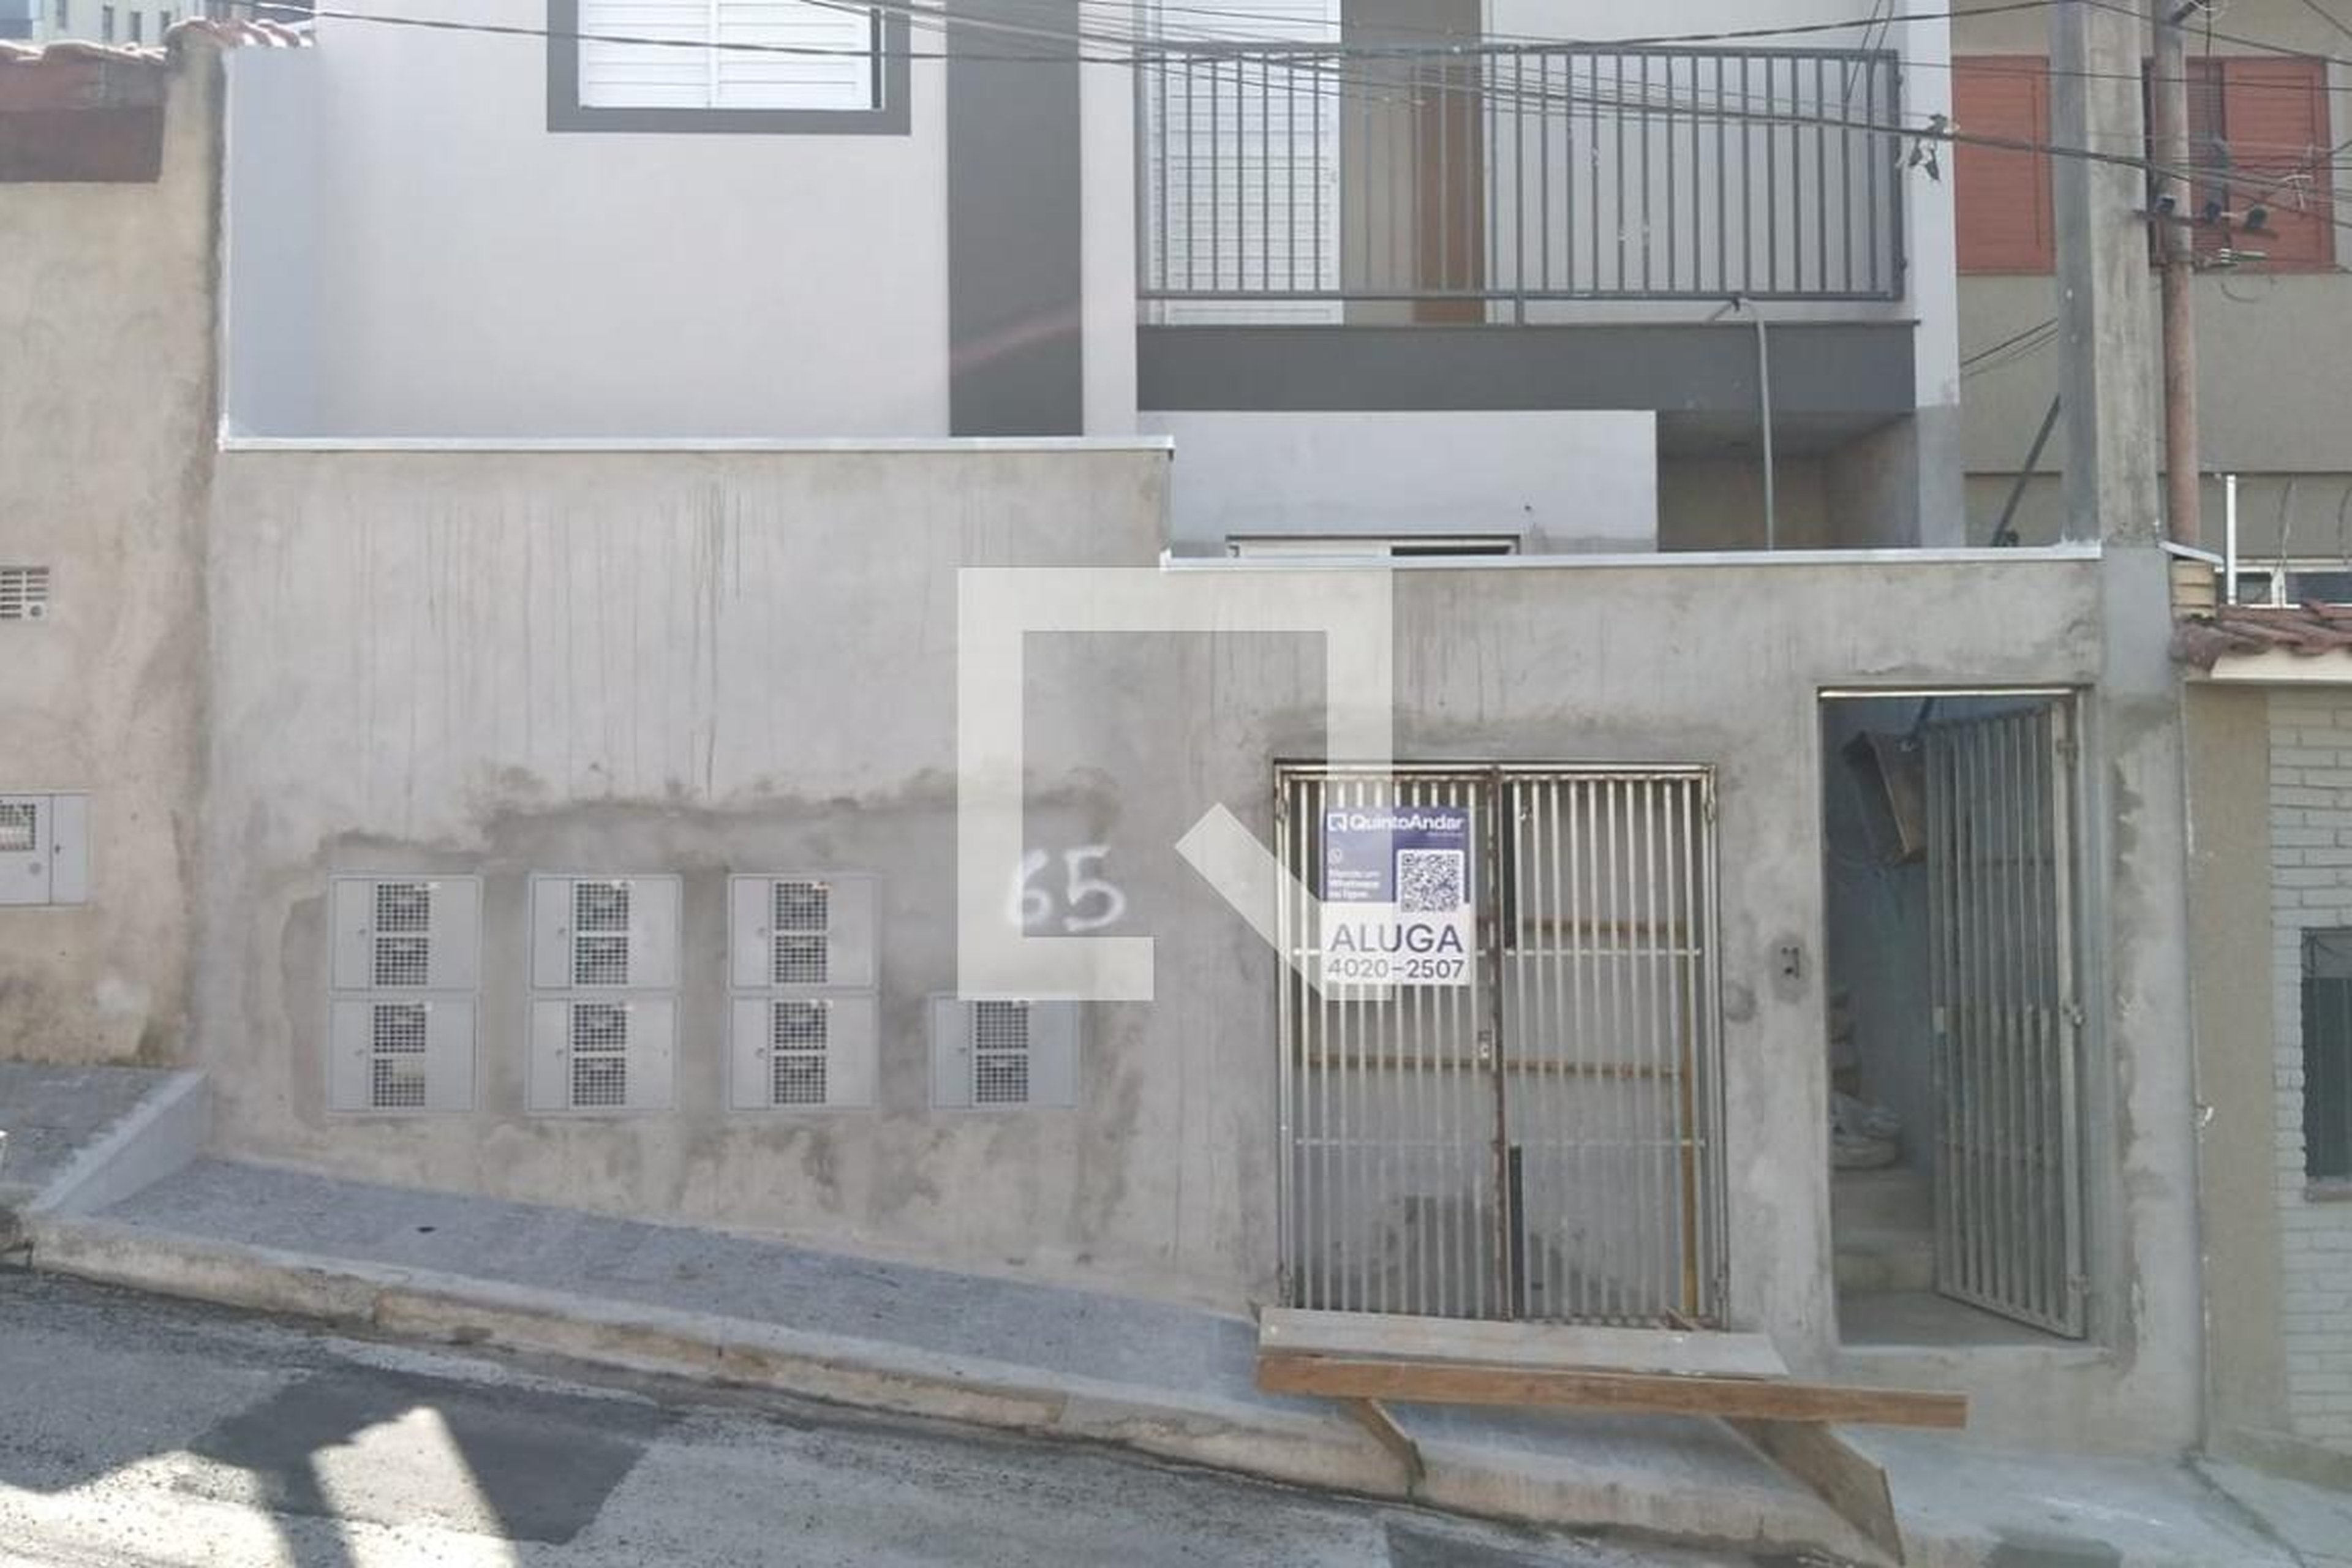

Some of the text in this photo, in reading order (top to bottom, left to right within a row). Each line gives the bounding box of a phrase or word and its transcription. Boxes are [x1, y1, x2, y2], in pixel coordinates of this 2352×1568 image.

[1349, 814, 1464, 830] QuintoAndar
[1009, 845, 1126, 931] 65
[1330, 923, 1463, 952] ALUGA
[1327, 959, 1464, 979] 4020-2507
